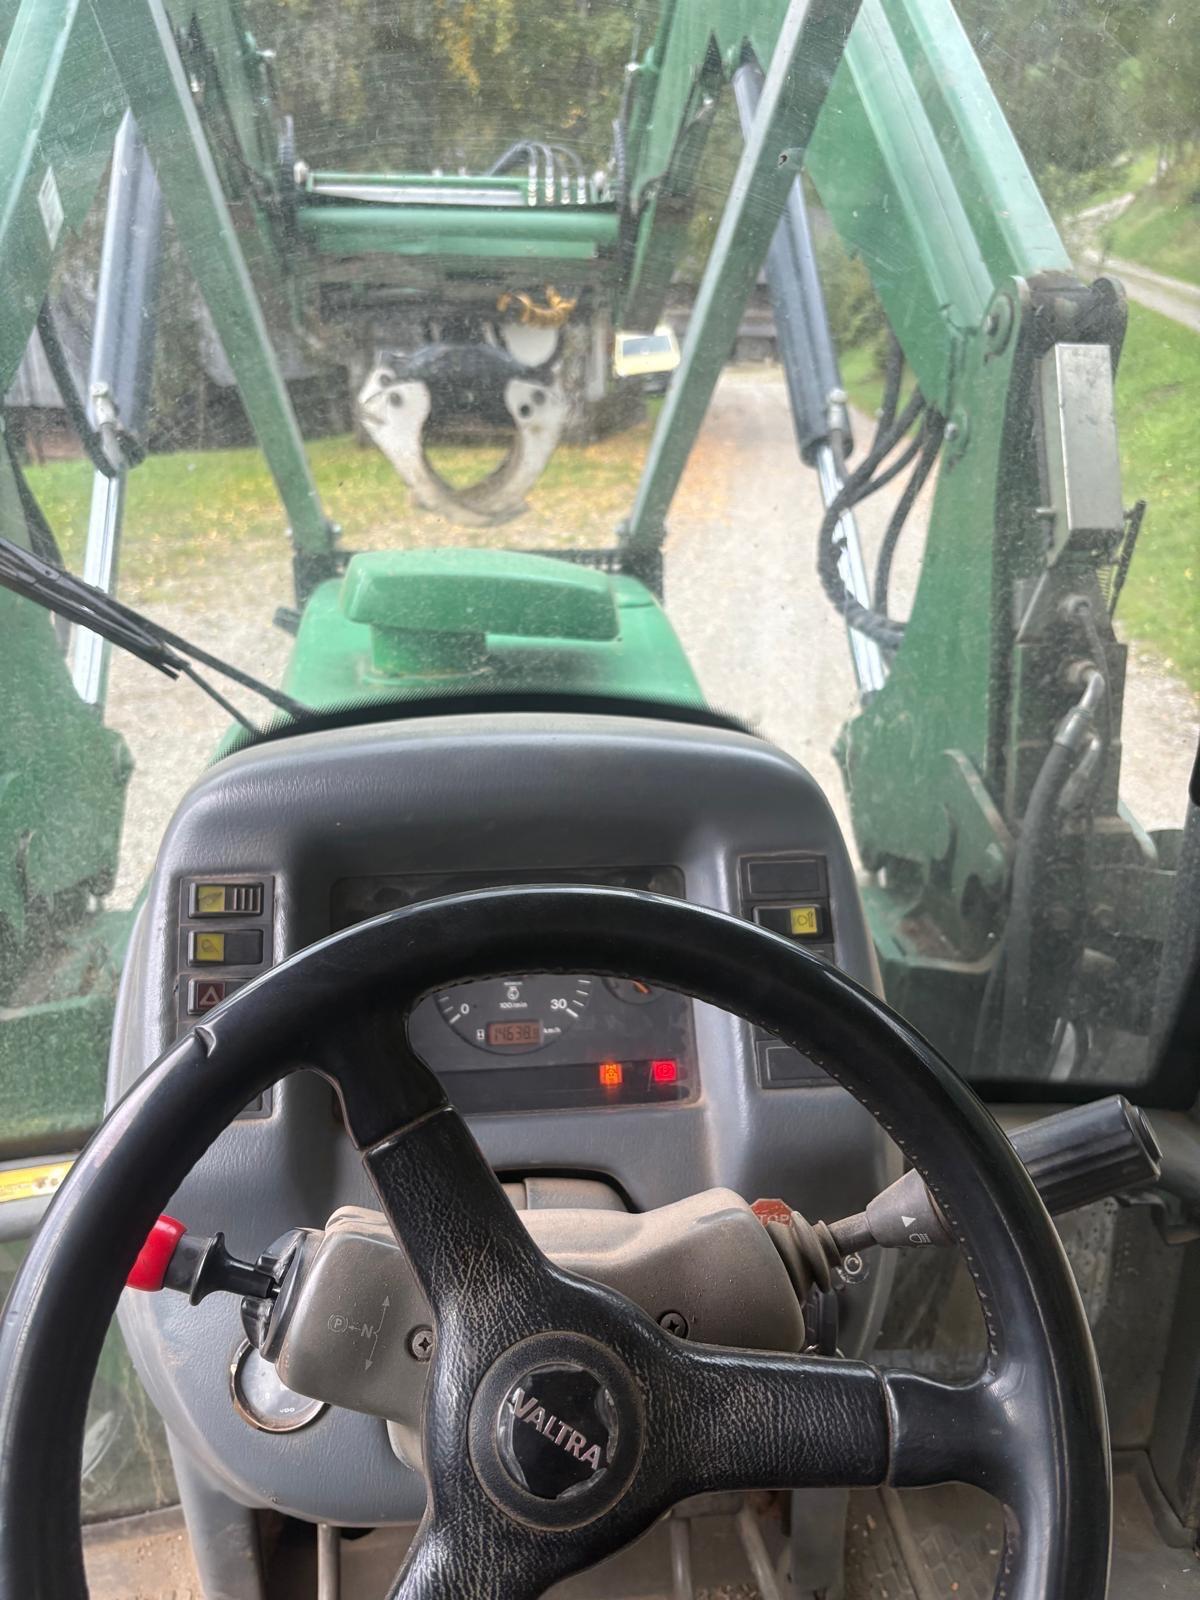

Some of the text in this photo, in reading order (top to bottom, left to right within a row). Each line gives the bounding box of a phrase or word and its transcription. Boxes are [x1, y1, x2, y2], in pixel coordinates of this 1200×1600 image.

[461, 1003, 470, 1014] 0
[550, 999, 567, 1010] 30
[360, 1323, 374, 1338] N
[512, 1387, 602, 1470] VALTRA
